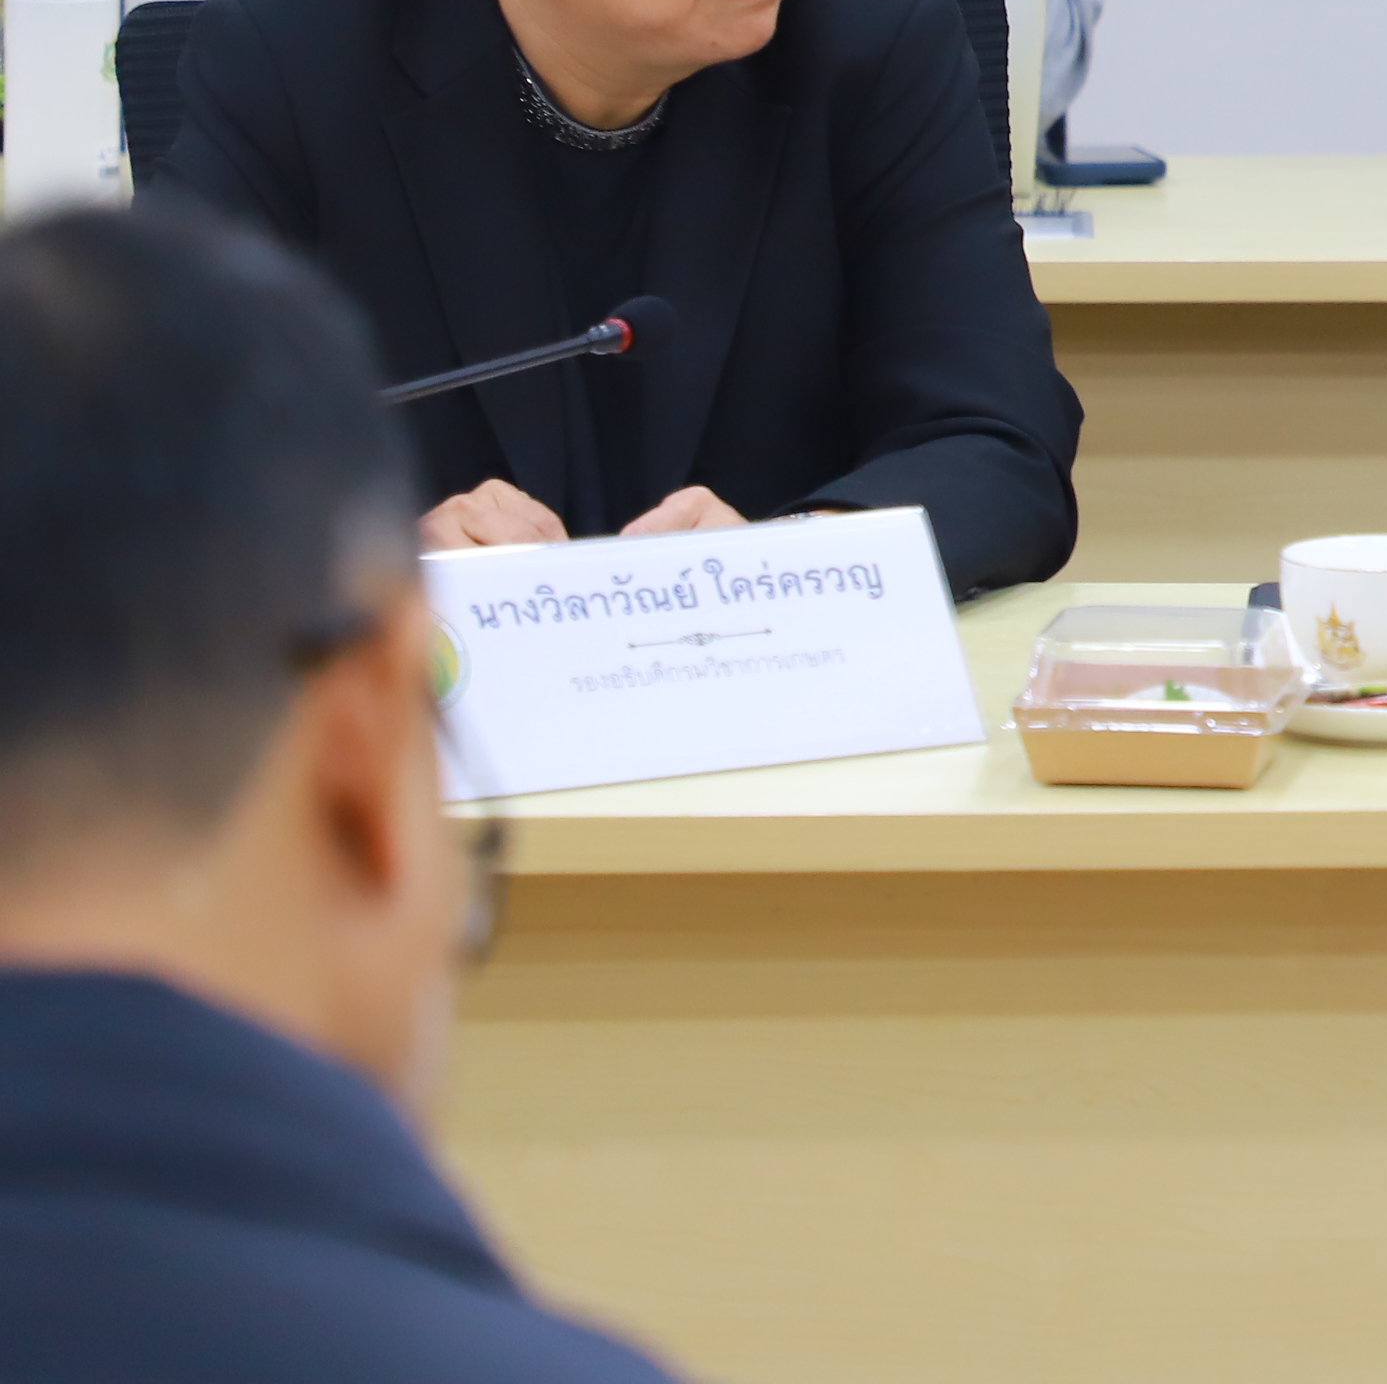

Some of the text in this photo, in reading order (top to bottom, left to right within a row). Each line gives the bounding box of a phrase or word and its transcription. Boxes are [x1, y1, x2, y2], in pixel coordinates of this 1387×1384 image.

[469, 558, 885, 630] นางวิลาวัณย์ ใคร่ครวญ
[569, 646, 848, 694] รองอธิบดีกรมวิชาการเกษตร
